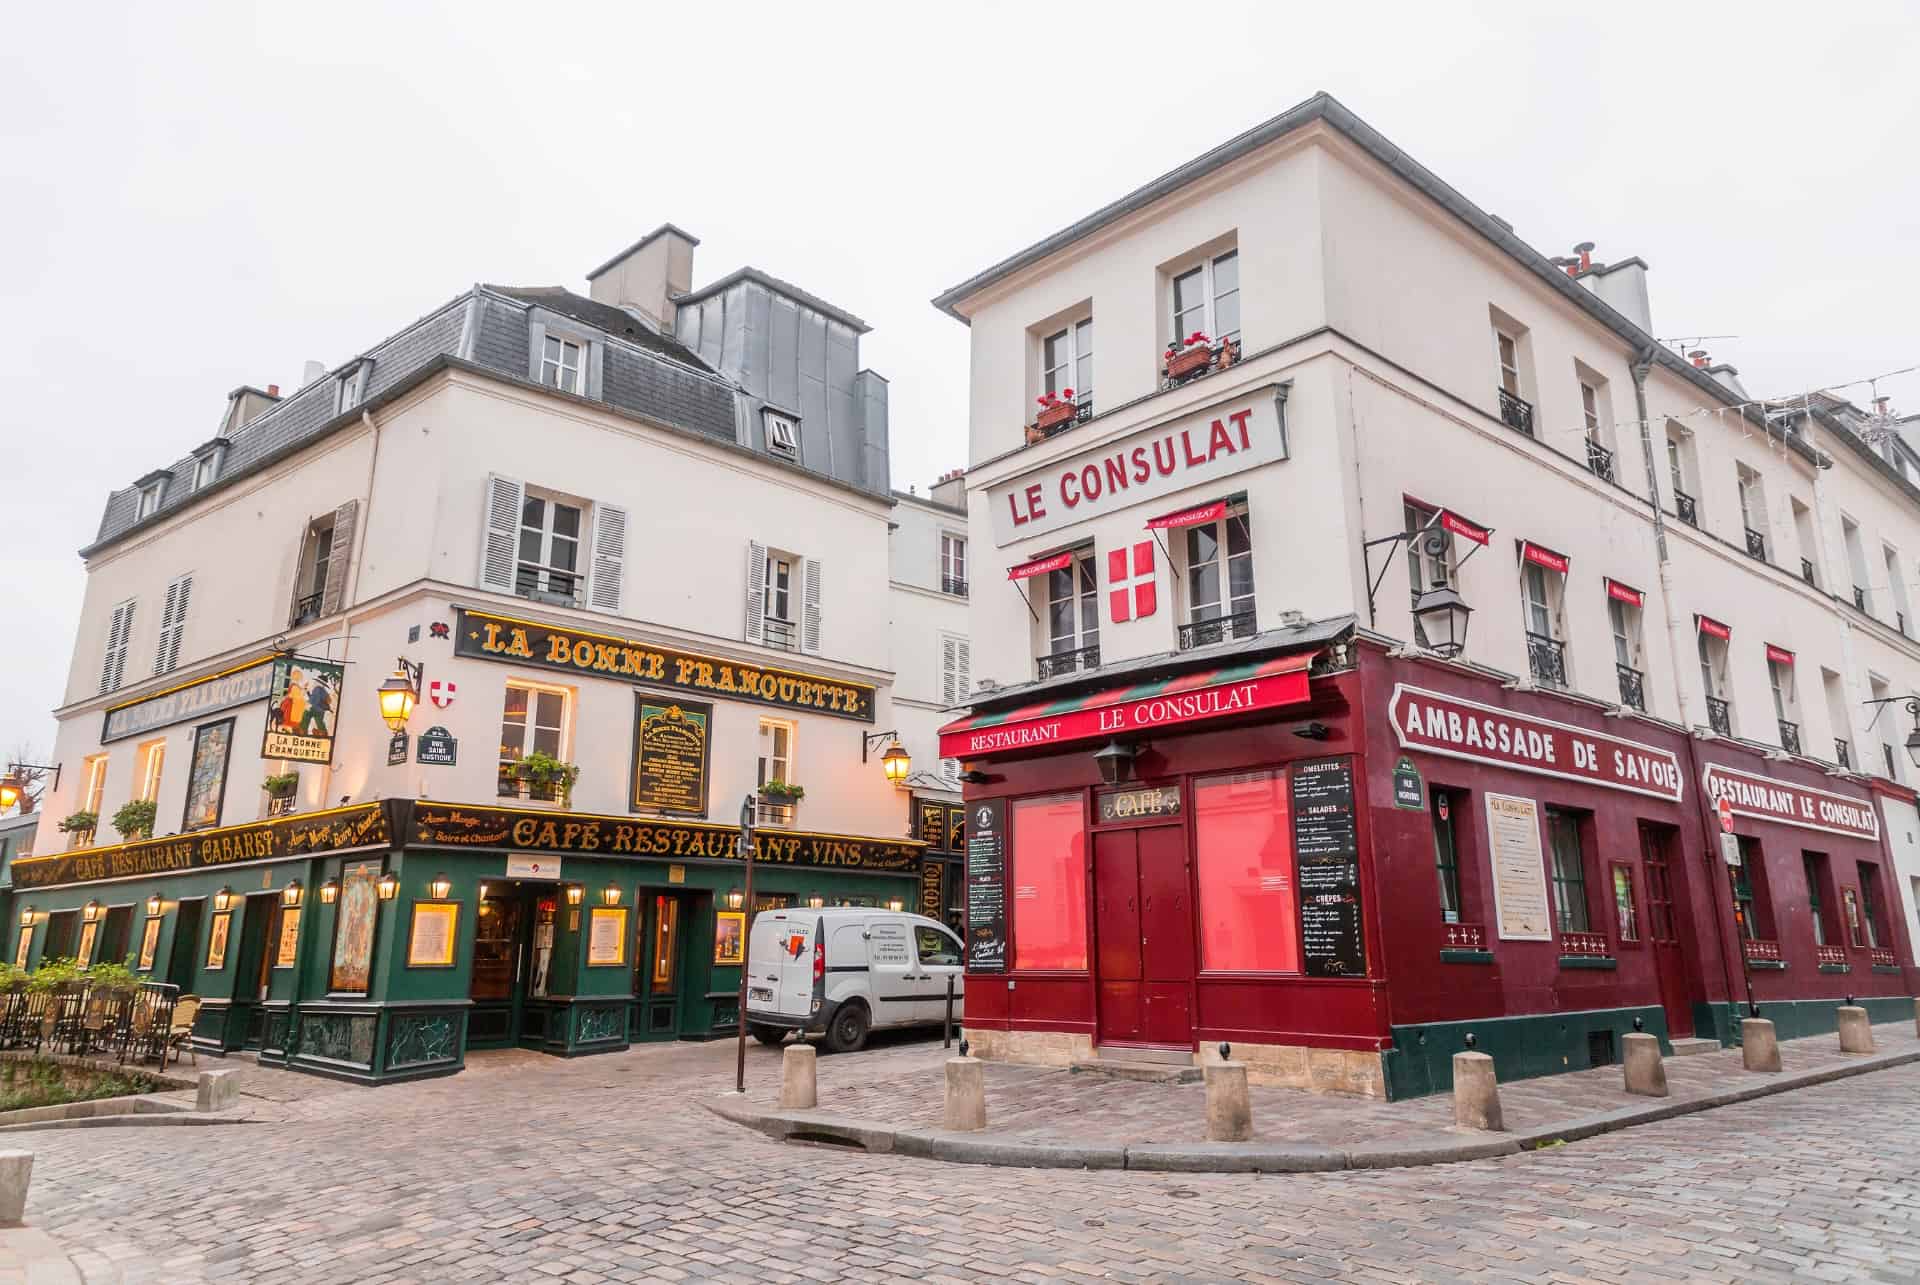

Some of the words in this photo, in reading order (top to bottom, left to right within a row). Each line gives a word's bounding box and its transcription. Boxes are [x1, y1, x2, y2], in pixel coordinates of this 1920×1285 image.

[1008, 483, 1046, 526] LE
[1060, 408, 1253, 508] CONSULAT
[1168, 508, 1215, 526] CONSULAT
[481, 622, 534, 658] LA
[547, 634, 665, 680] BONNE
[675, 657, 859, 713] FRANQUETTE
[970, 723, 1061, 751] RESTAURANT
[1100, 707, 1125, 730] LE
[1134, 684, 1259, 725] CONSULAT
[269, 744, 326, 759] FRANQUETTE
[276, 735, 288, 745] LA
[293, 737, 321, 748] BONNE
[1406, 702, 1556, 763] AMBASSADE
[1573, 739, 1599, 772] DE
[1614, 750, 1677, 791] SAVOIE
[1303, 763, 1340, 773] OMELETTES
[1117, 788, 1162, 817] CAFÉ
[1308, 805, 1337, 815] SALADES
[1710, 775, 1795, 815] RESTAURANT
[1800, 795, 1816, 819] LE
[1819, 800, 1875, 831] CONSULAT
[435, 830, 459, 843] Boire
[513, 818, 601, 850] CAFÉ
[811, 840, 862, 865] VINS
[76, 853, 105, 880] CAFÉ
[111, 842, 192, 875] RESTAURANT
[202, 830, 273, 864] CABARET
[1315, 894, 1342, 903] CRÊPES
